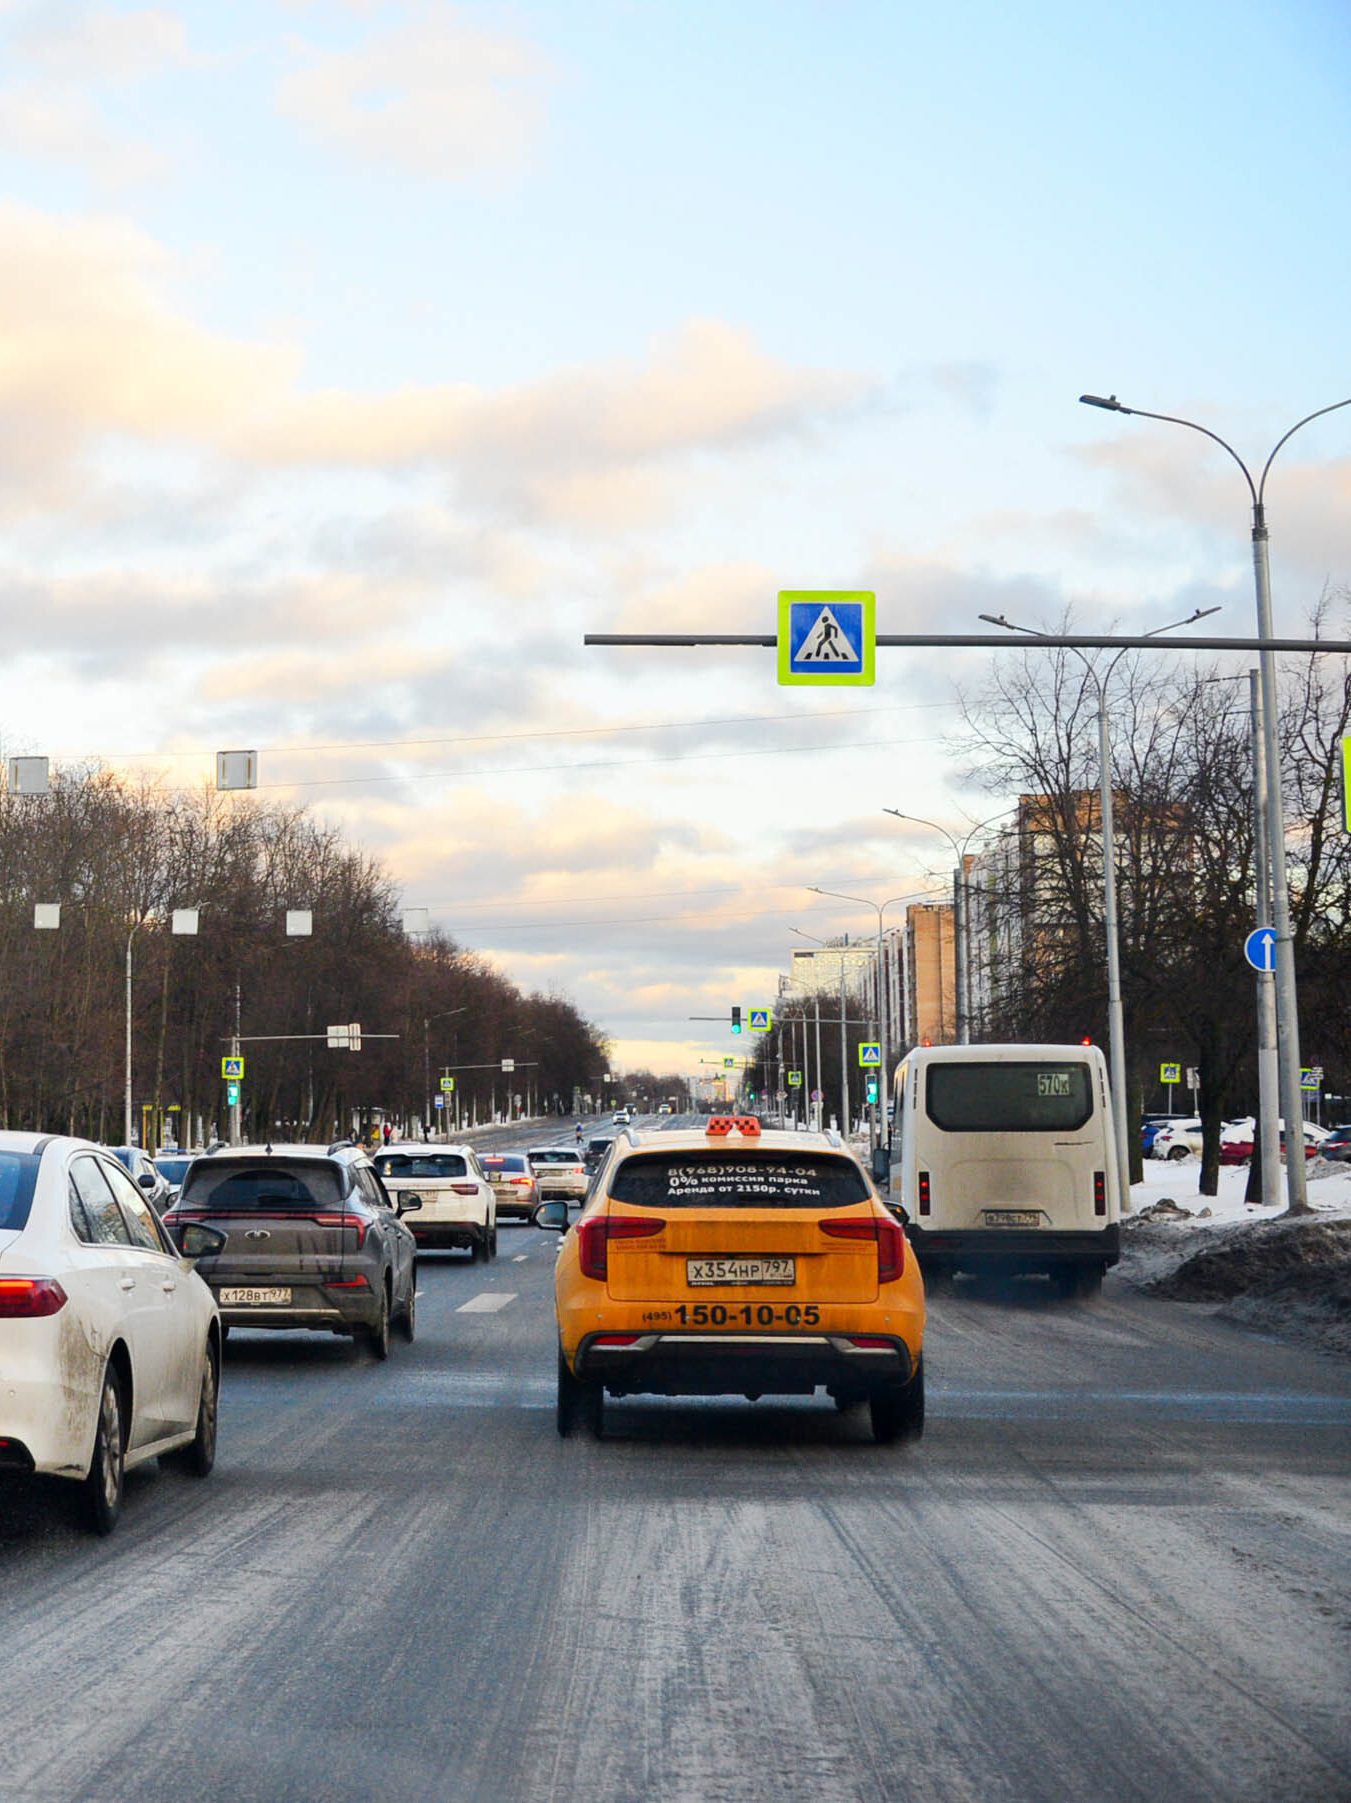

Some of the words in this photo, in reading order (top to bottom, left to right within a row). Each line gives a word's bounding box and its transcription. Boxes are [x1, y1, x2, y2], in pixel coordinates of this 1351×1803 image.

[669, 1176, 698, 1187] 0%
[701, 1176, 765, 1184] комиссия
[768, 1176, 808, 1186] парка
[667, 1186, 715, 1195] Аренда
[736, 1184, 781, 1194] 2150р.
[783, 1187, 820, 1196] сутки
[762, 1260, 789, 1273] 797
[642, 1311, 672, 1323] (495)
[673, 1304, 820, 1326] 150-10-05
